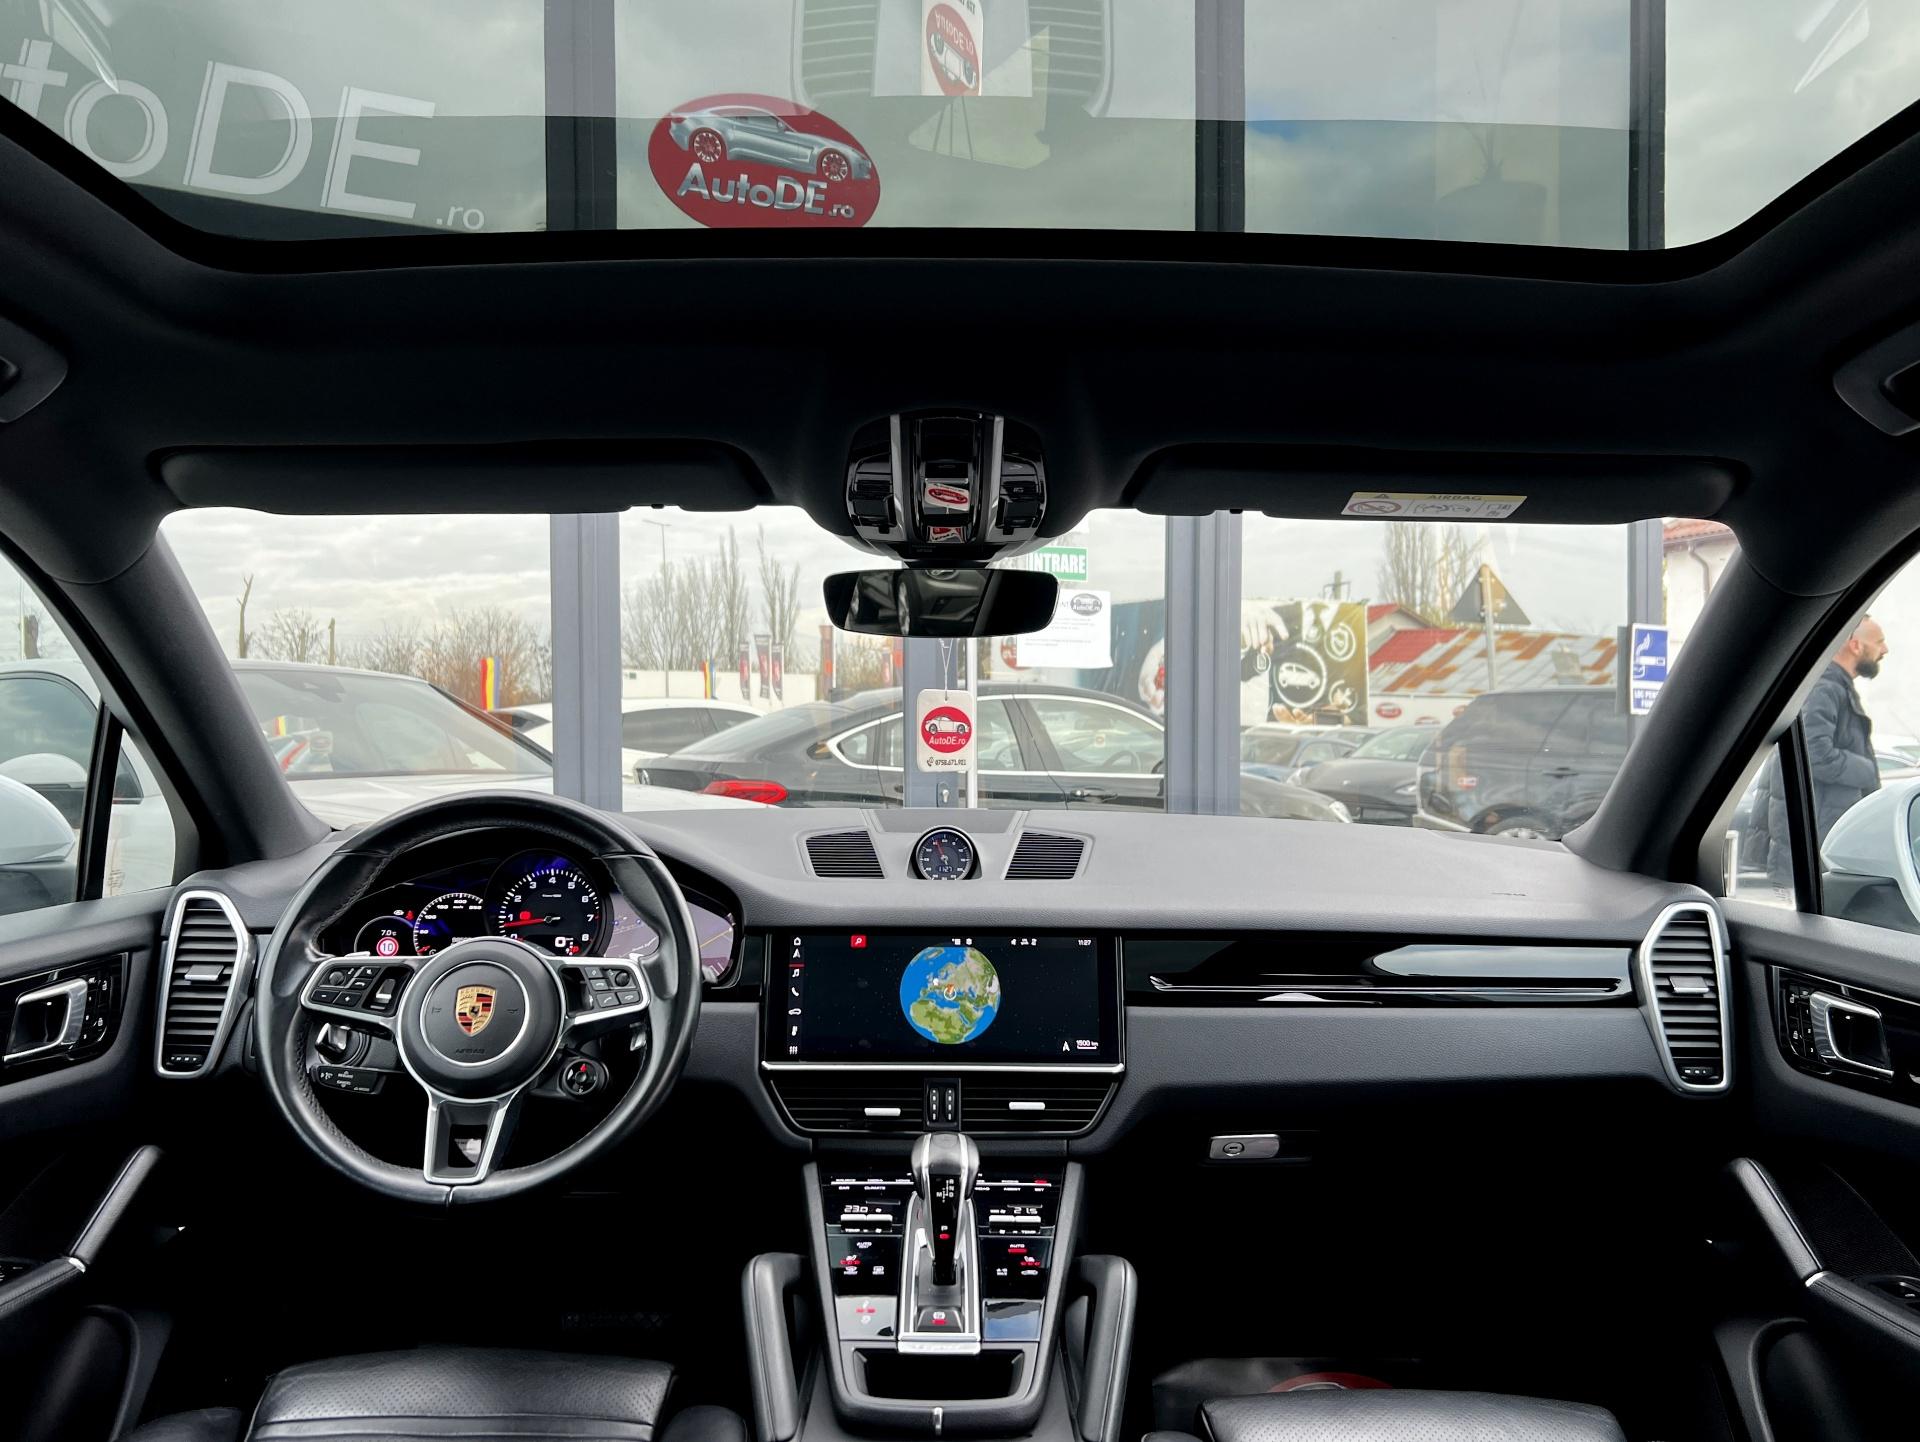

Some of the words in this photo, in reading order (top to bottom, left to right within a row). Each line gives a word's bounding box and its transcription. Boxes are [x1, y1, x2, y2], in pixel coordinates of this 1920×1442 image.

[1427, 493, 1482, 502] AIRBAG
[1030, 553, 1086, 574] INTRARE
[929, 736, 966, 745] AutoDE.ro
[529, 881, 537, 889] 3
[567, 881, 576, 889] 5
[581, 895, 589, 903] 6
[586, 914, 595, 922] 7
[382, 942, 394, 952] 10
